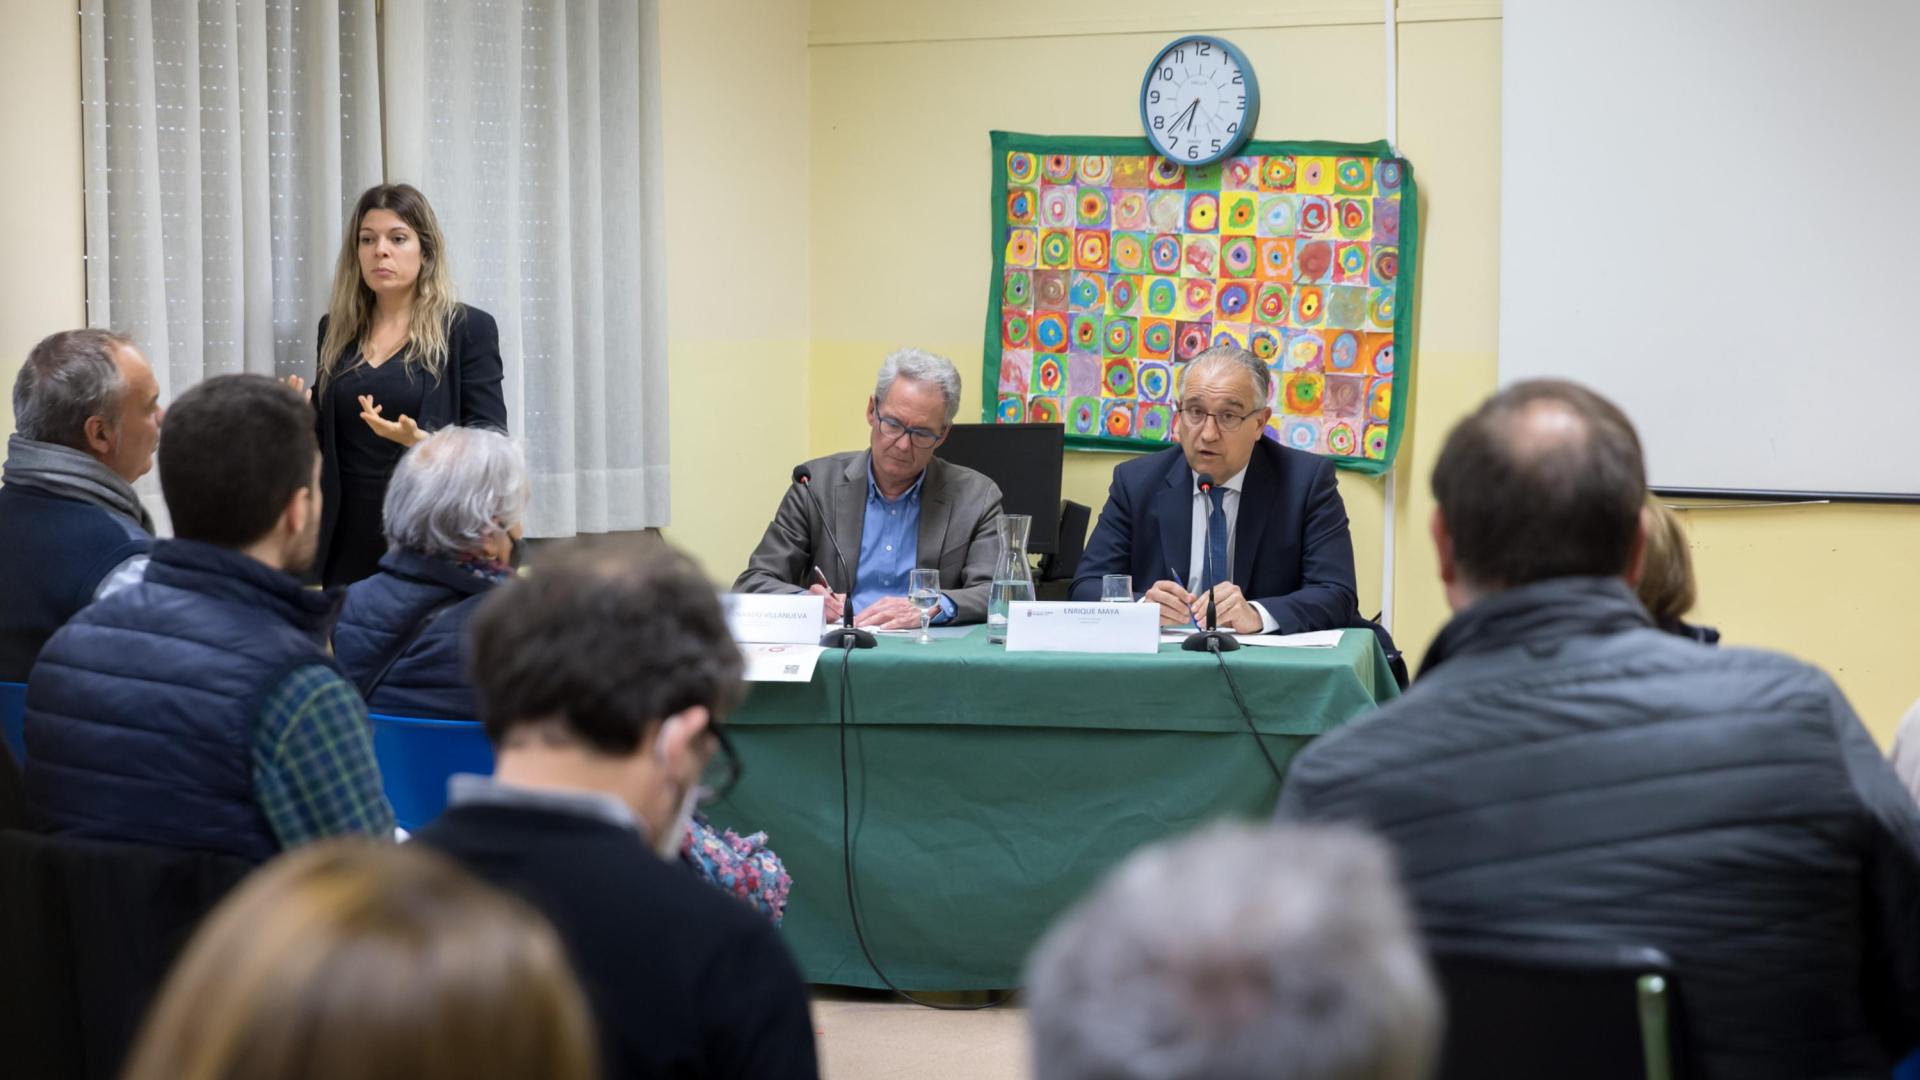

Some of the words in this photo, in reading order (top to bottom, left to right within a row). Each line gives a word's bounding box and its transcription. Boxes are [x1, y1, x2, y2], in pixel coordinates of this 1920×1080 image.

[1195, 42, 1211, 56] 12
[1174, 49, 1184, 64] 11
[1223, 51, 1228, 65] 1
[1158, 66, 1173, 81] 10
[1232, 70, 1243, 84] 2
[1150, 90, 1160, 104] 9
[1236, 95, 1246, 110] 3
[1153, 115, 1164, 129] 8
[1226, 122, 1238, 133] 4
[1168, 136, 1178, 150] 7
[1211, 139, 1221, 153] 5
[1188, 145, 1199, 159] 6
[764, 611, 808, 619] VILLANUEVA
[1063, 608, 1096, 616] ENRIQUE
[1097, 608, 1120, 616] MAYA
